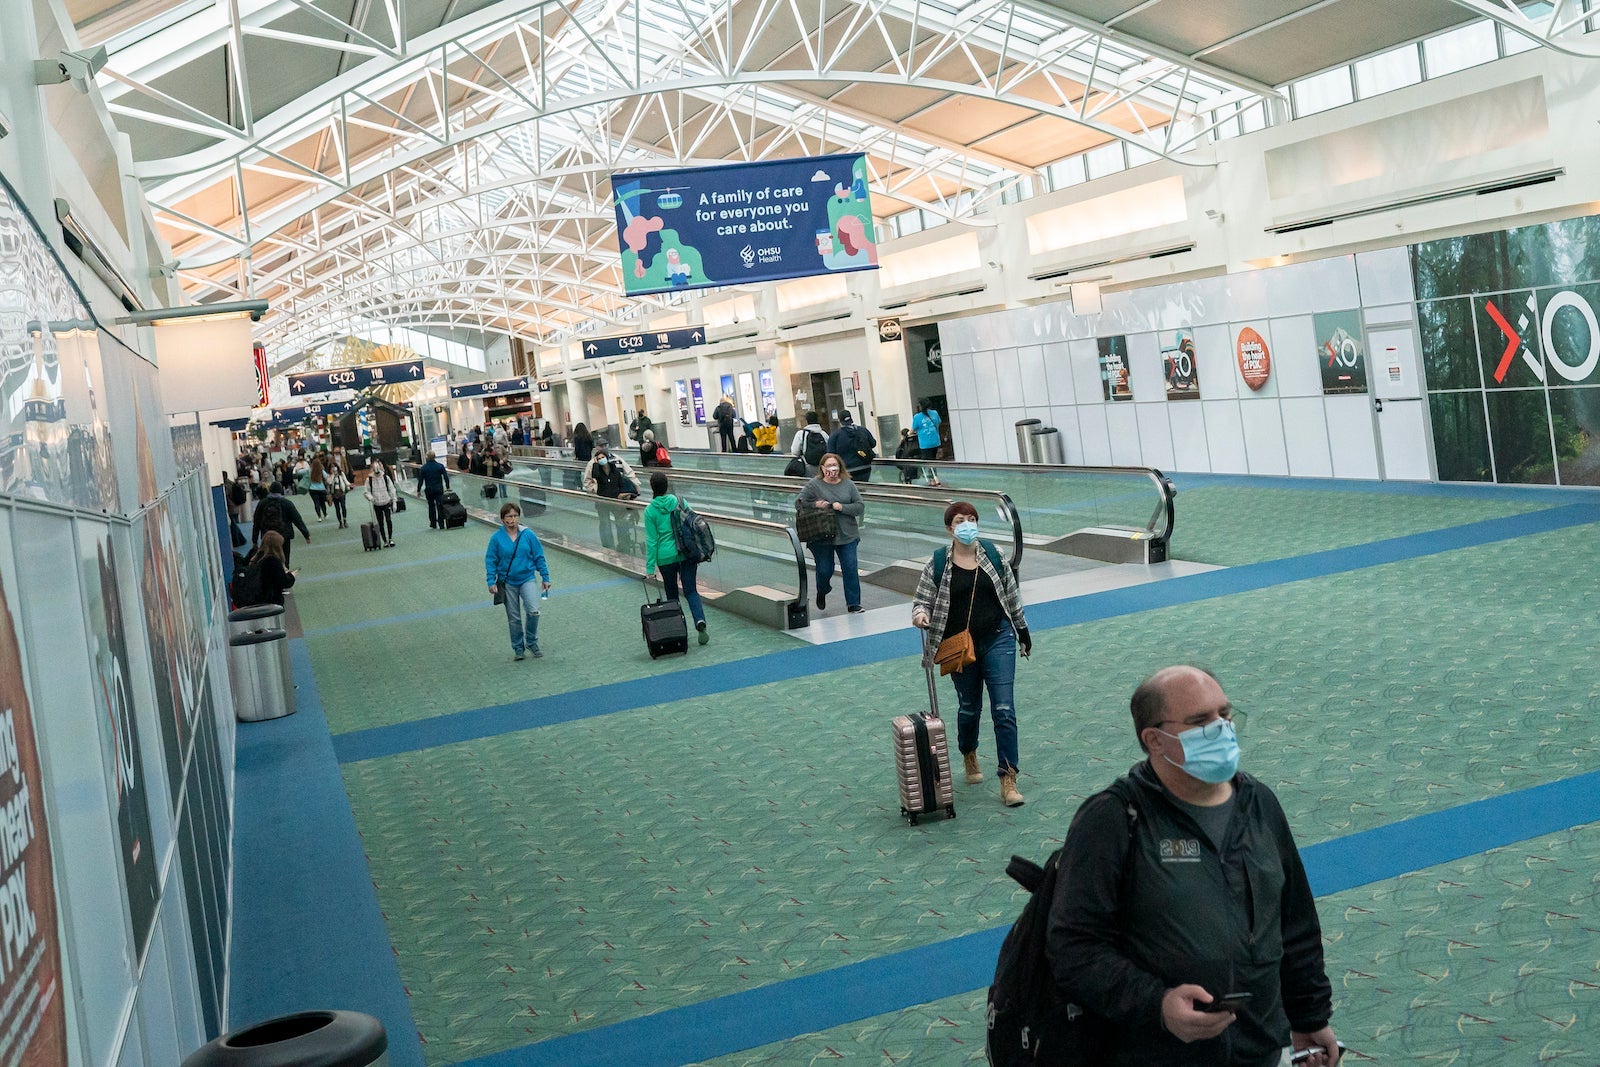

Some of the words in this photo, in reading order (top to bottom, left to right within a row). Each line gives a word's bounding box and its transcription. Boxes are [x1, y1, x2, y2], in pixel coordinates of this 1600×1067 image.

[699, 193, 709, 205] A
[712, 189, 753, 204] family
[756, 187, 770, 200] of
[773, 187, 803, 198] care
[696, 210, 716, 222] for
[720, 205, 781, 219] everyone
[785, 202, 809, 216] you
[717, 224, 747, 236] care
[750, 217, 793, 233] about.
[757, 247, 781, 256] OHSU
[758, 255, 782, 263] Health
[618, 336, 643, 349] C5-C23
[1240, 341, 1262, 352] Building
[1241, 351, 1251, 361] the
[1250, 350, 1266, 360] heart
[328, 372, 356, 386] C5-C23
[1160, 839, 1200, 856] 2019
